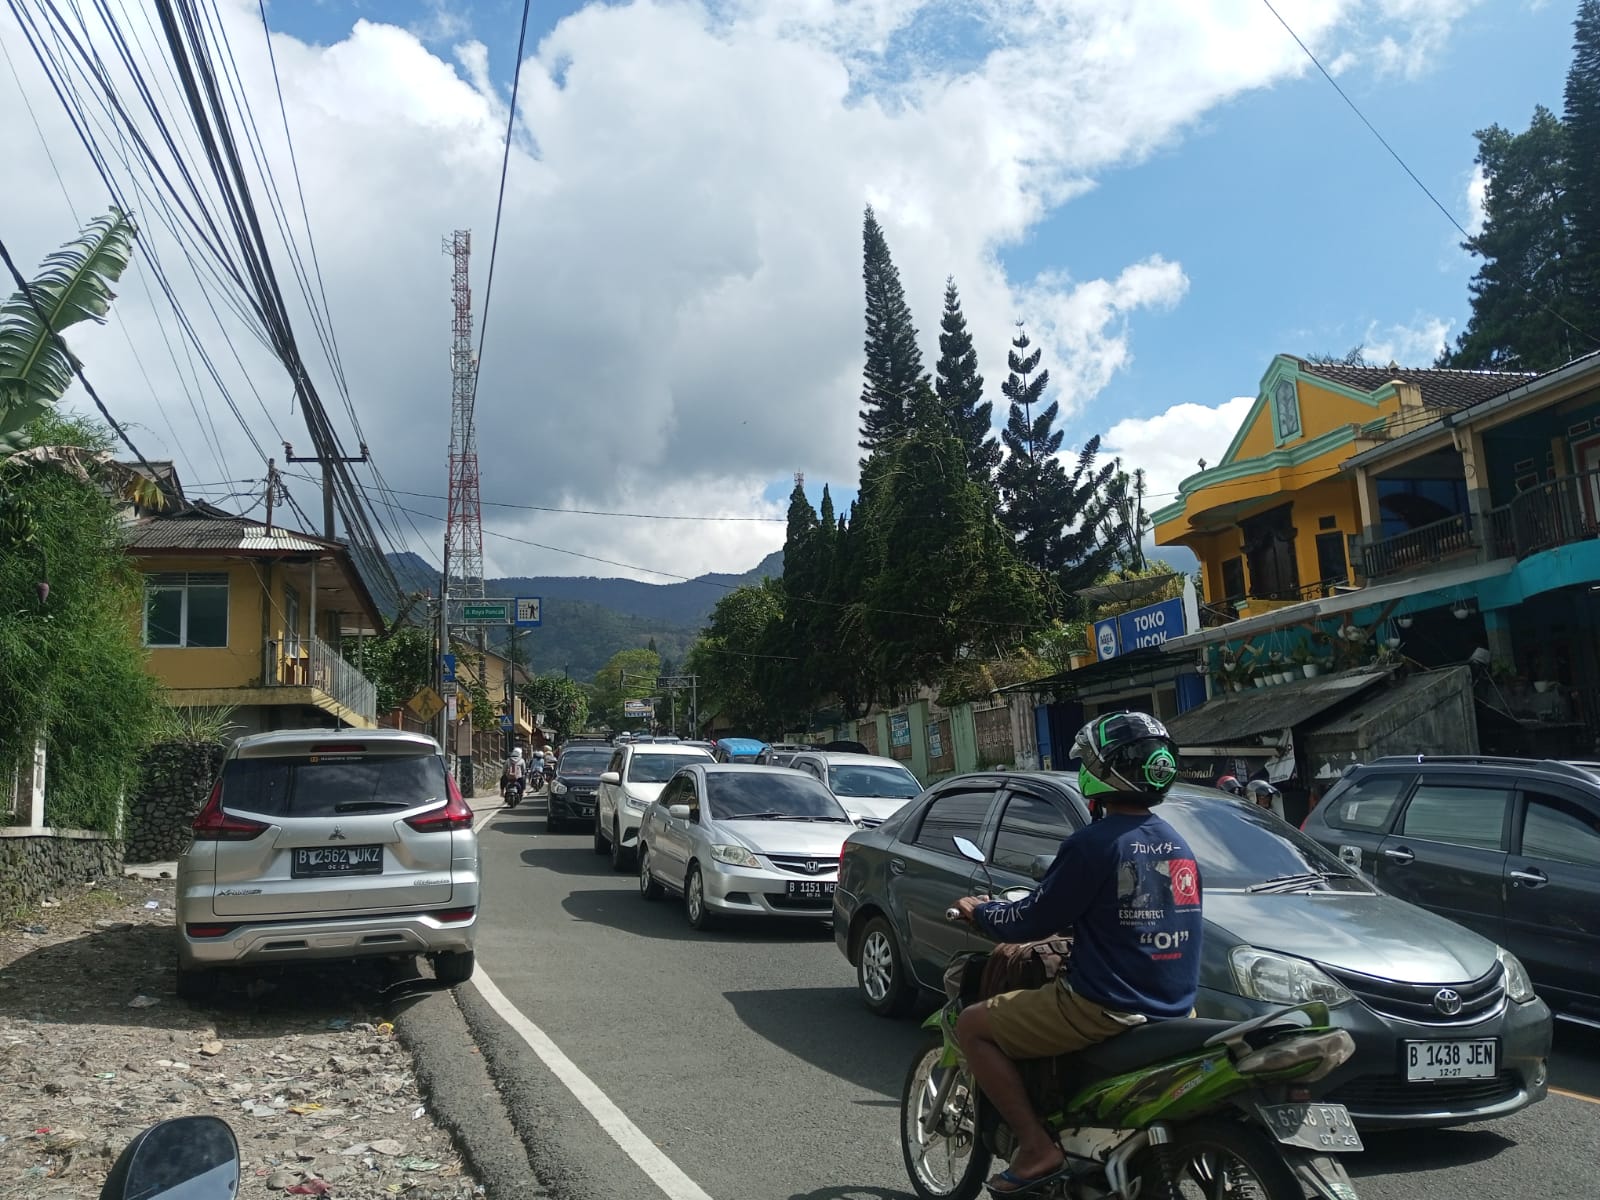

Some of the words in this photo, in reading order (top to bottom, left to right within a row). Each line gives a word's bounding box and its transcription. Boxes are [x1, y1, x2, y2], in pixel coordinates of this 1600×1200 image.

[1134, 610, 1165, 632] TOKO
[299, 850, 307, 864] B
[318, 848, 348, 863] 2562
[789, 882, 795, 892] B
[800, 882, 821, 893] 1151
[1410, 1047, 1418, 1067] B
[1426, 1045, 1461, 1066] 1438
[1466, 1045, 1493, 1065] JEN
